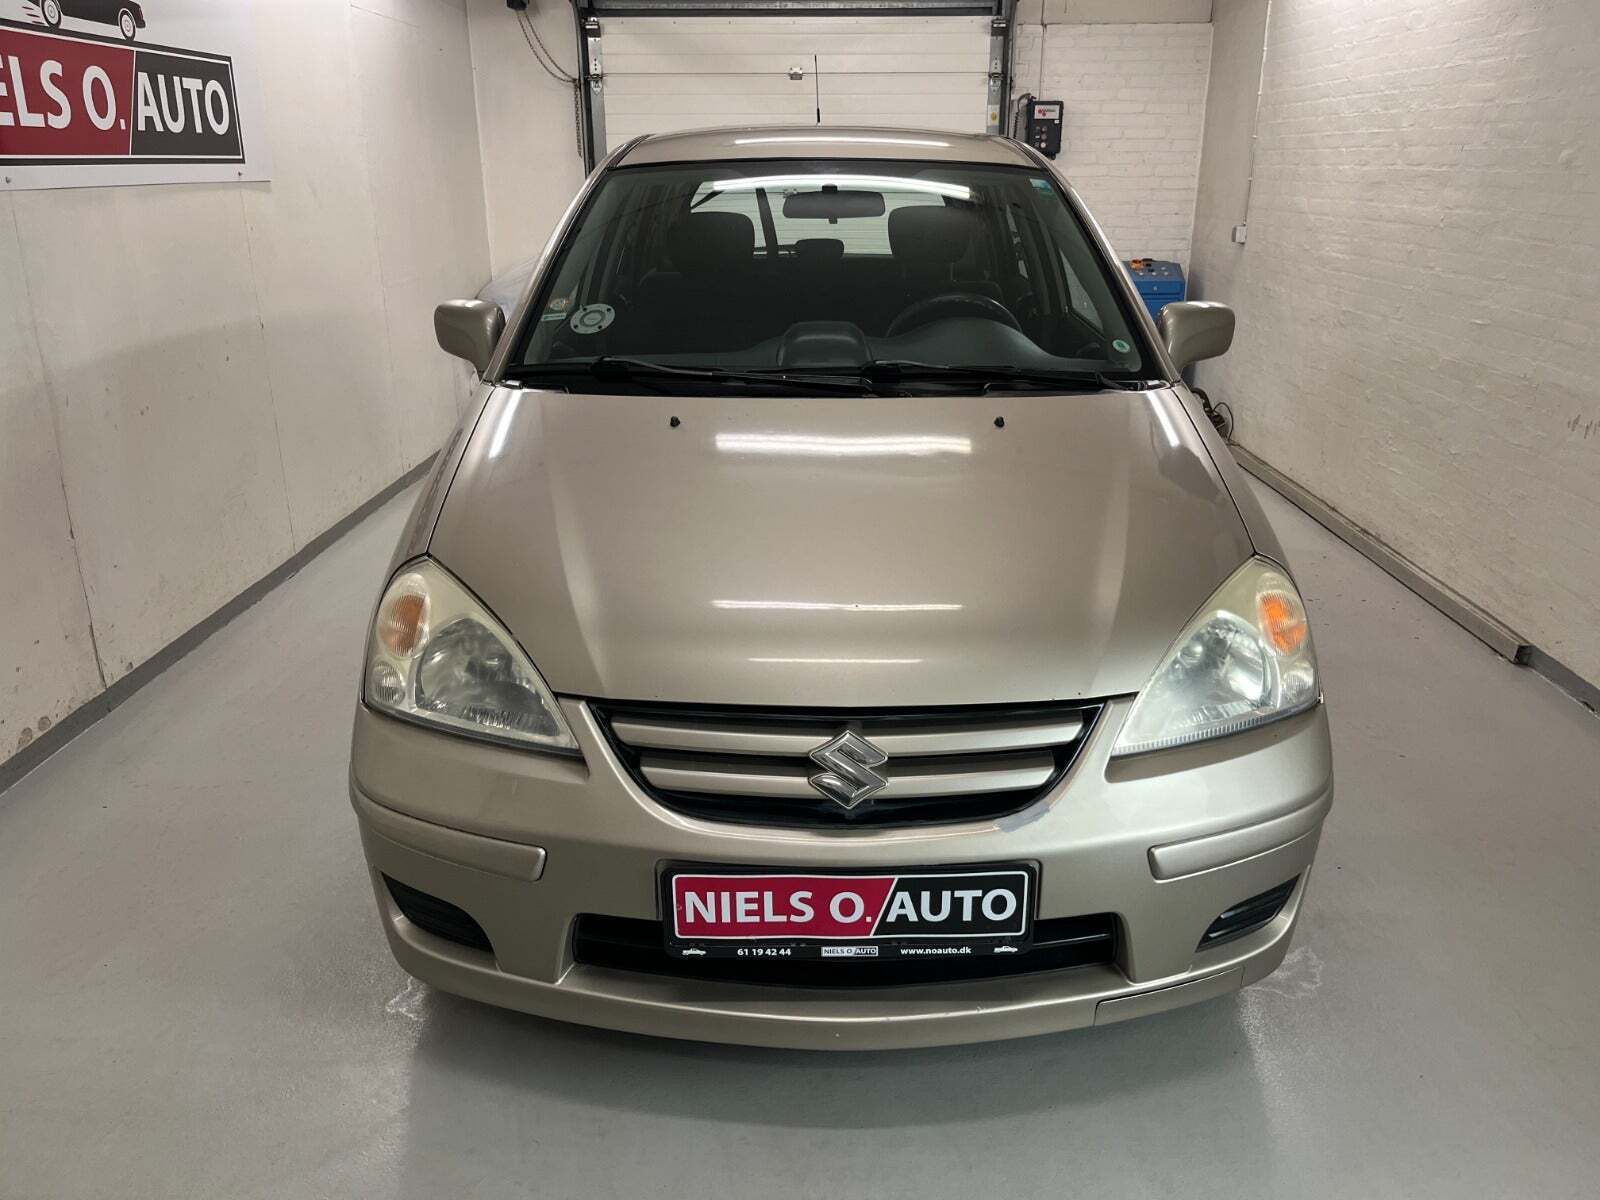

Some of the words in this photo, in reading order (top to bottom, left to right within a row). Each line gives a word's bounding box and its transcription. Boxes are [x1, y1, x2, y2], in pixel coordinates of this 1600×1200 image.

[82, 65, 127, 131] O.
[137, 71, 230, 135] AUTO
[685, 890, 815, 924] NIELS
[829, 891, 872, 924] O.
[885, 888, 1017, 923] AUTO
[737, 948, 749, 956] 61
[752, 948, 763, 956] 19
[765, 948, 778, 956] 42
[779, 948, 792, 956] 44
[900, 946, 972, 955] www.noauto.dk
